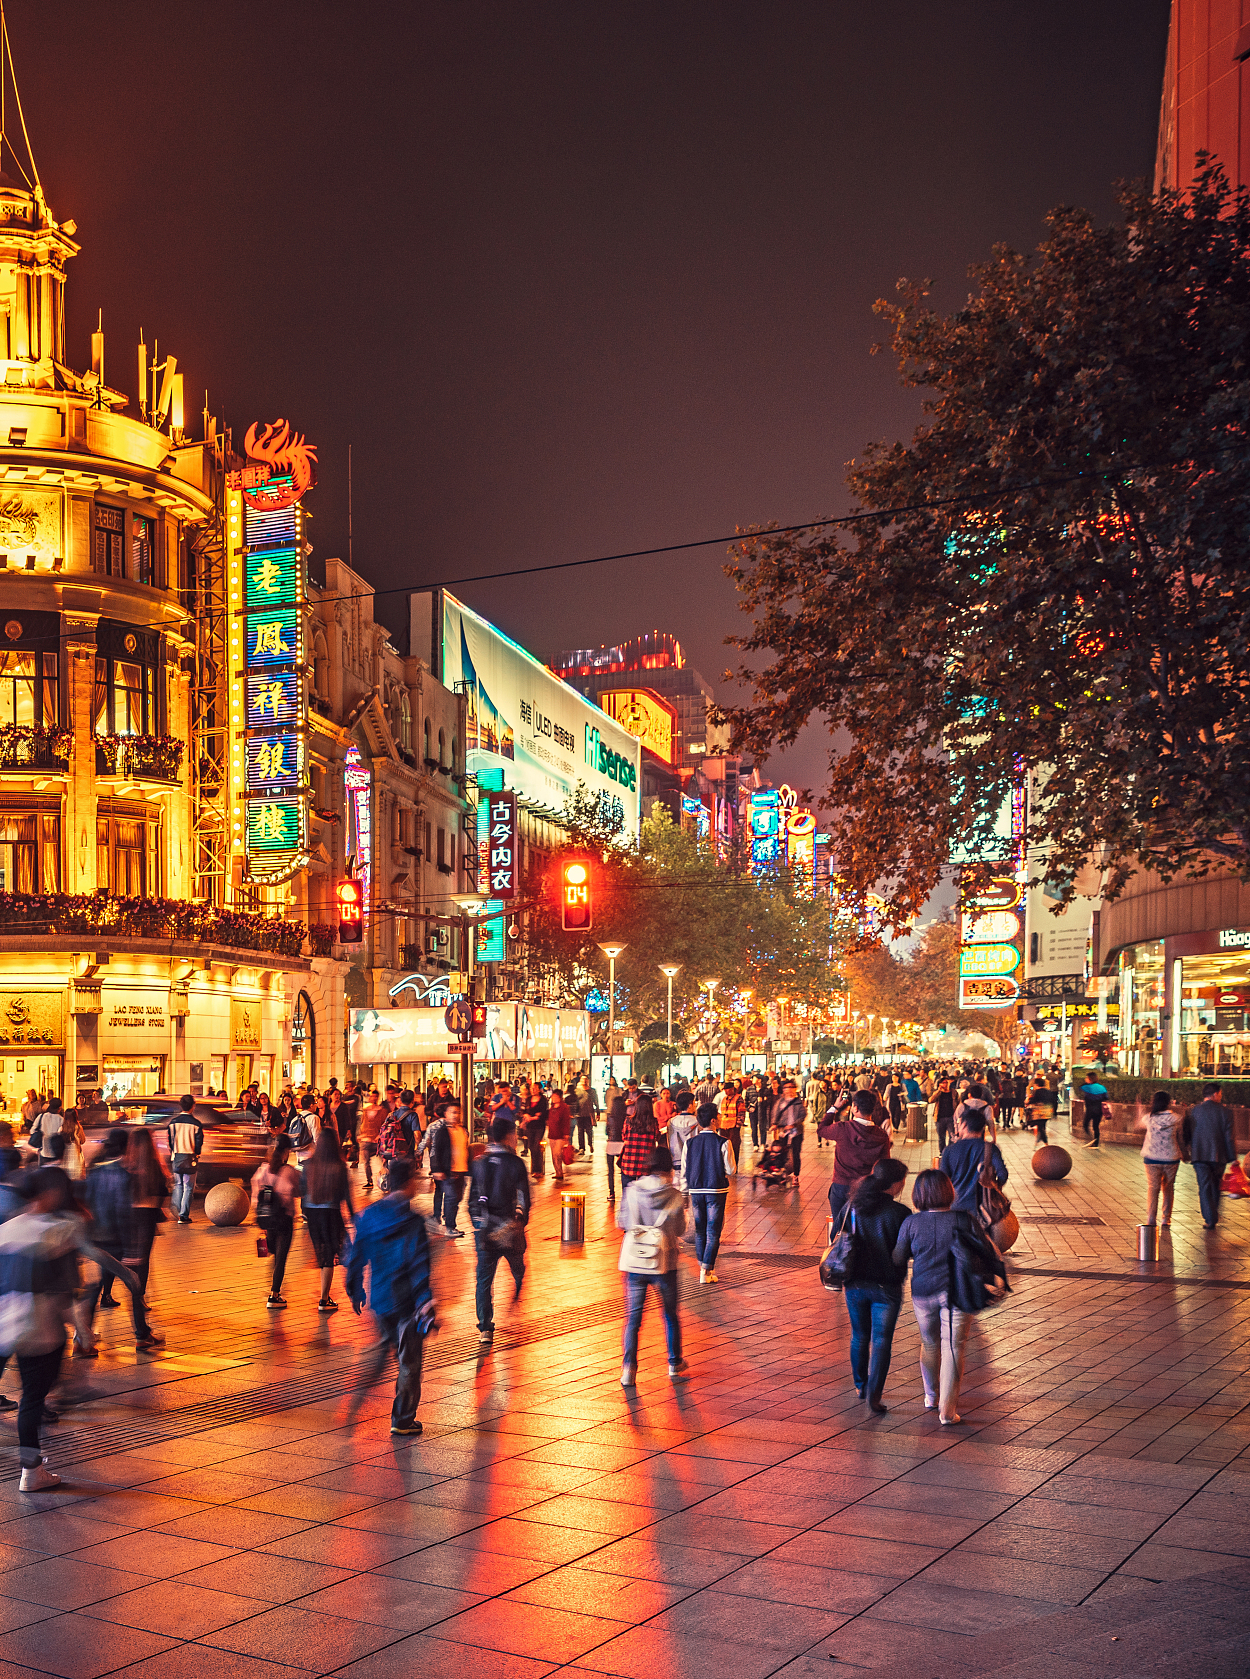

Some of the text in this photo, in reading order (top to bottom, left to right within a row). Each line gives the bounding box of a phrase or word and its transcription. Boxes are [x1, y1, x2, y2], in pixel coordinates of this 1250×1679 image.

[251, 558, 291, 842] 老鳳祥銀樓
[535, 711, 552, 738] ULED
[585, 721, 637, 793] Hisense
[491, 800, 513, 890] 古今内衣
[568, 886, 587, 903] 04
[342, 904, 359, 920] 04
[963, 950, 1013, 962] 巴西烤肉
[113, 1005, 127, 1014] LAO
[129, 1005, 144, 1014] FENG
[108, 1017, 165, 1027] JEWELLERS STORE
